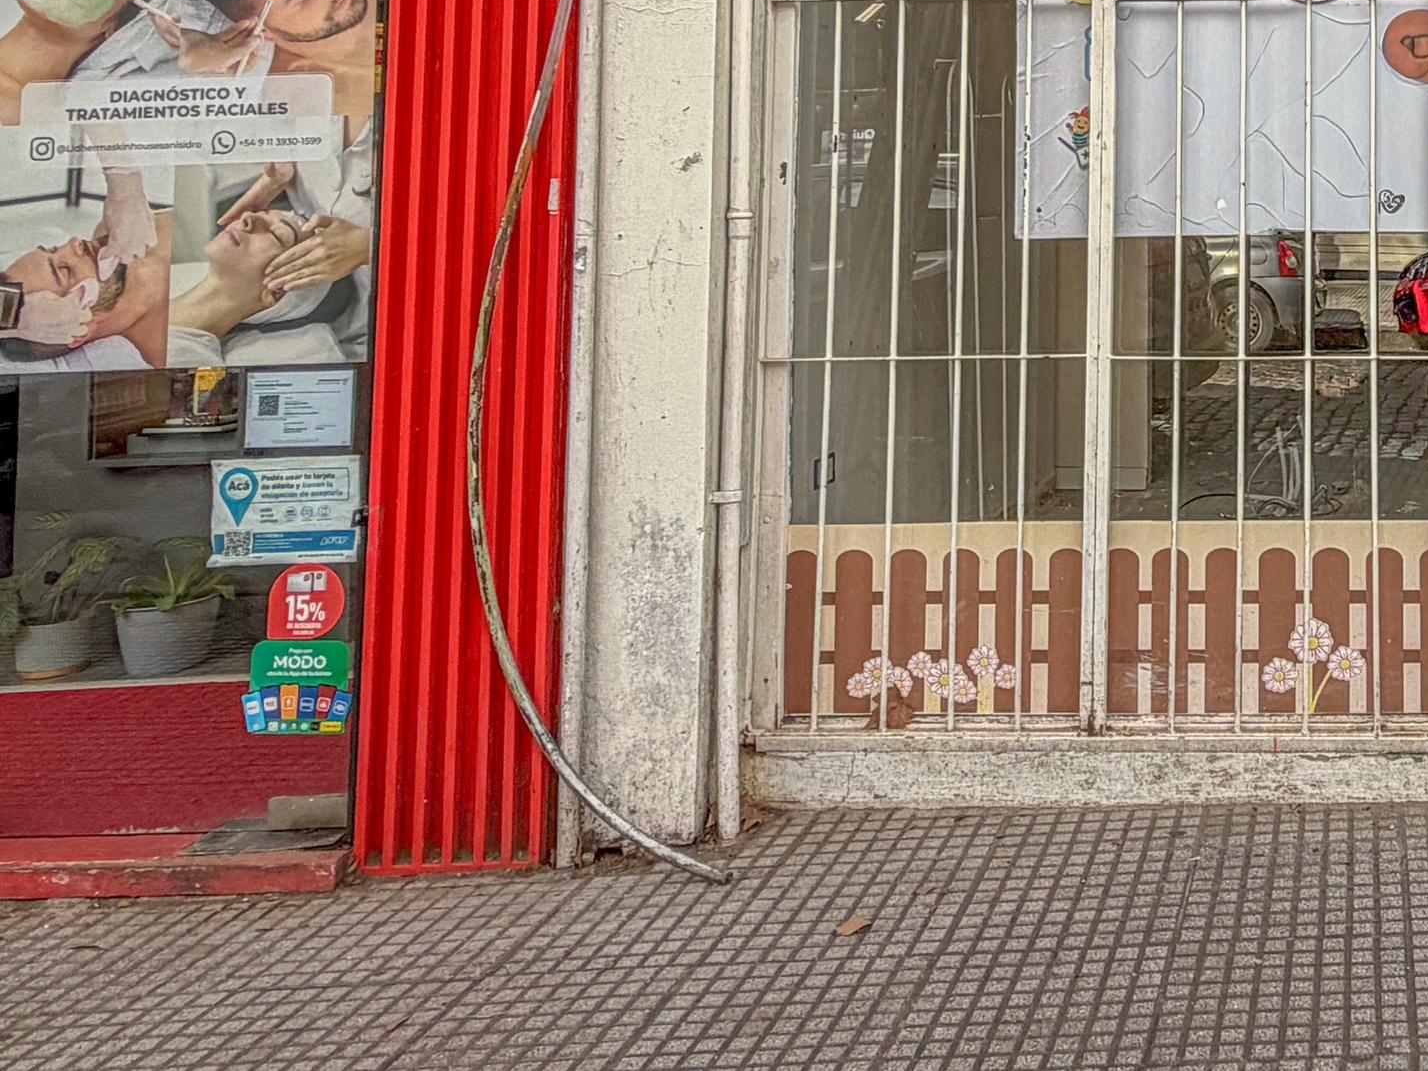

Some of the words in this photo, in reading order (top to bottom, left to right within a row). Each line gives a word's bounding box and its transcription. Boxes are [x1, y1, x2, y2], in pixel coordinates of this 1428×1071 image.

[109, 86, 231, 103] DIAGNÓSTICO
[234, 87, 247, 99] Y
[65, 105, 201, 122] TRATAMIENTOS
[205, 102, 289, 118] FACIALES
[228, 479, 250, 491] Acá
[285, 595, 326, 622] 15%
[273, 656, 327, 669] MODO
